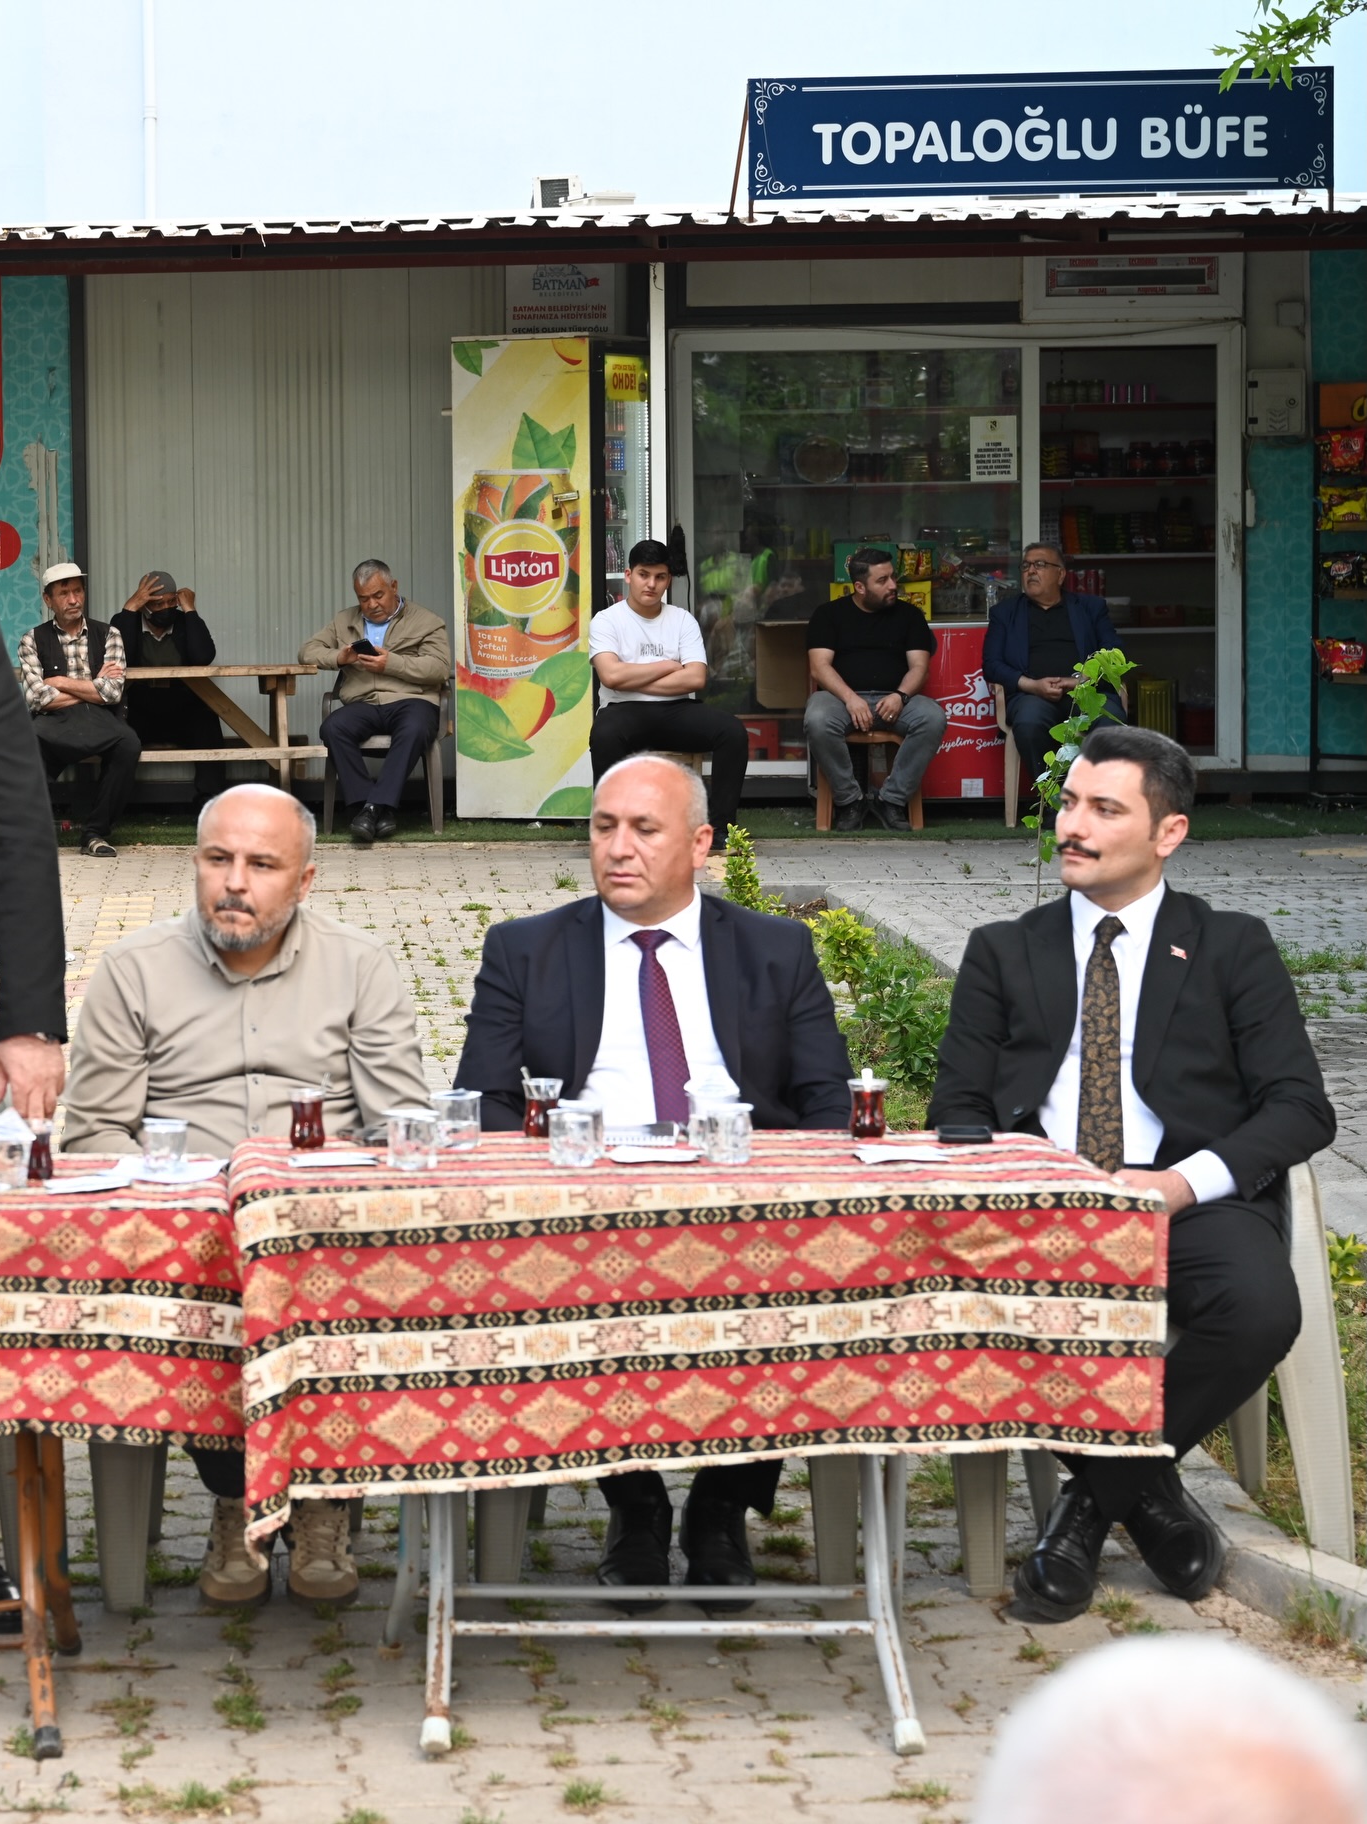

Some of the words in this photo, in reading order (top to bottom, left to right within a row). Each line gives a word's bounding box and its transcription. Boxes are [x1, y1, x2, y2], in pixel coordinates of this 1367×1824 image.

[812, 105, 1117, 165] TOPALOĞLU
[1140, 103, 1269, 160] BÜFE
[532, 277, 588, 290] BATMAN
[512, 312, 559, 320] ESNAFIMIZA
[560, 311, 607, 319] HEDİYESİDİR
[491, 558, 554, 582] Lipton
[478, 632, 492, 641] ICE
[493, 635, 508, 643] TEA
[478, 640, 507, 652] Şeftali
[477, 650, 507, 661] Aromalı
[510, 653, 538, 663] İçecek
[945, 699, 995, 720] şenpi
